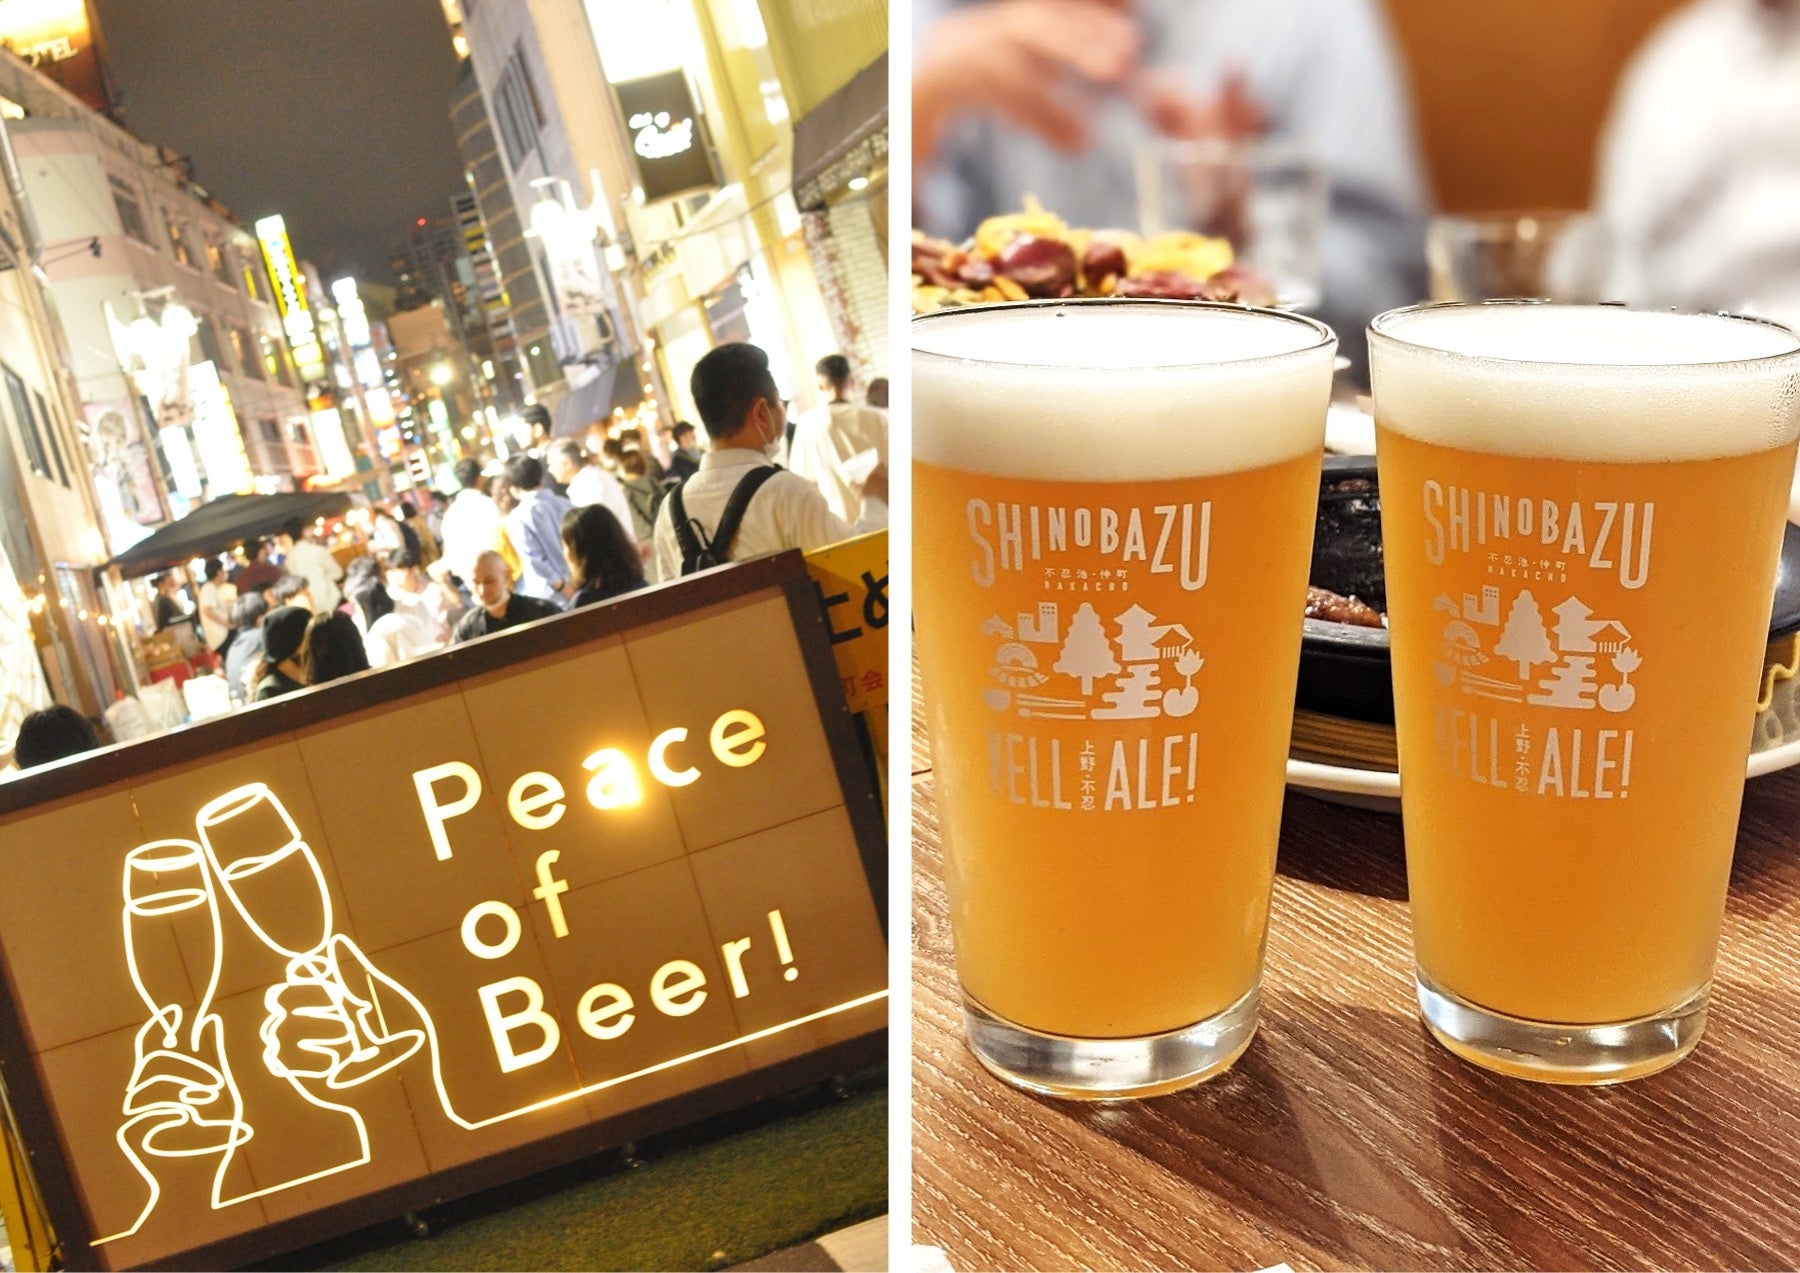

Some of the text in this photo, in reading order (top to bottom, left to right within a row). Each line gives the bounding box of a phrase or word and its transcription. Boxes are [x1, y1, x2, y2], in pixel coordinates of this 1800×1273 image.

[967, 498, 1212, 591] SHINOBAZU
[1423, 480, 1655, 589] SHINOBAZU
[412, 709, 767, 862] Peace
[1104, 732, 1198, 811] ALE!
[1537, 727, 1634, 798] ALE!
[460, 849, 570, 960] of
[477, 909, 799, 1074] Beer!
